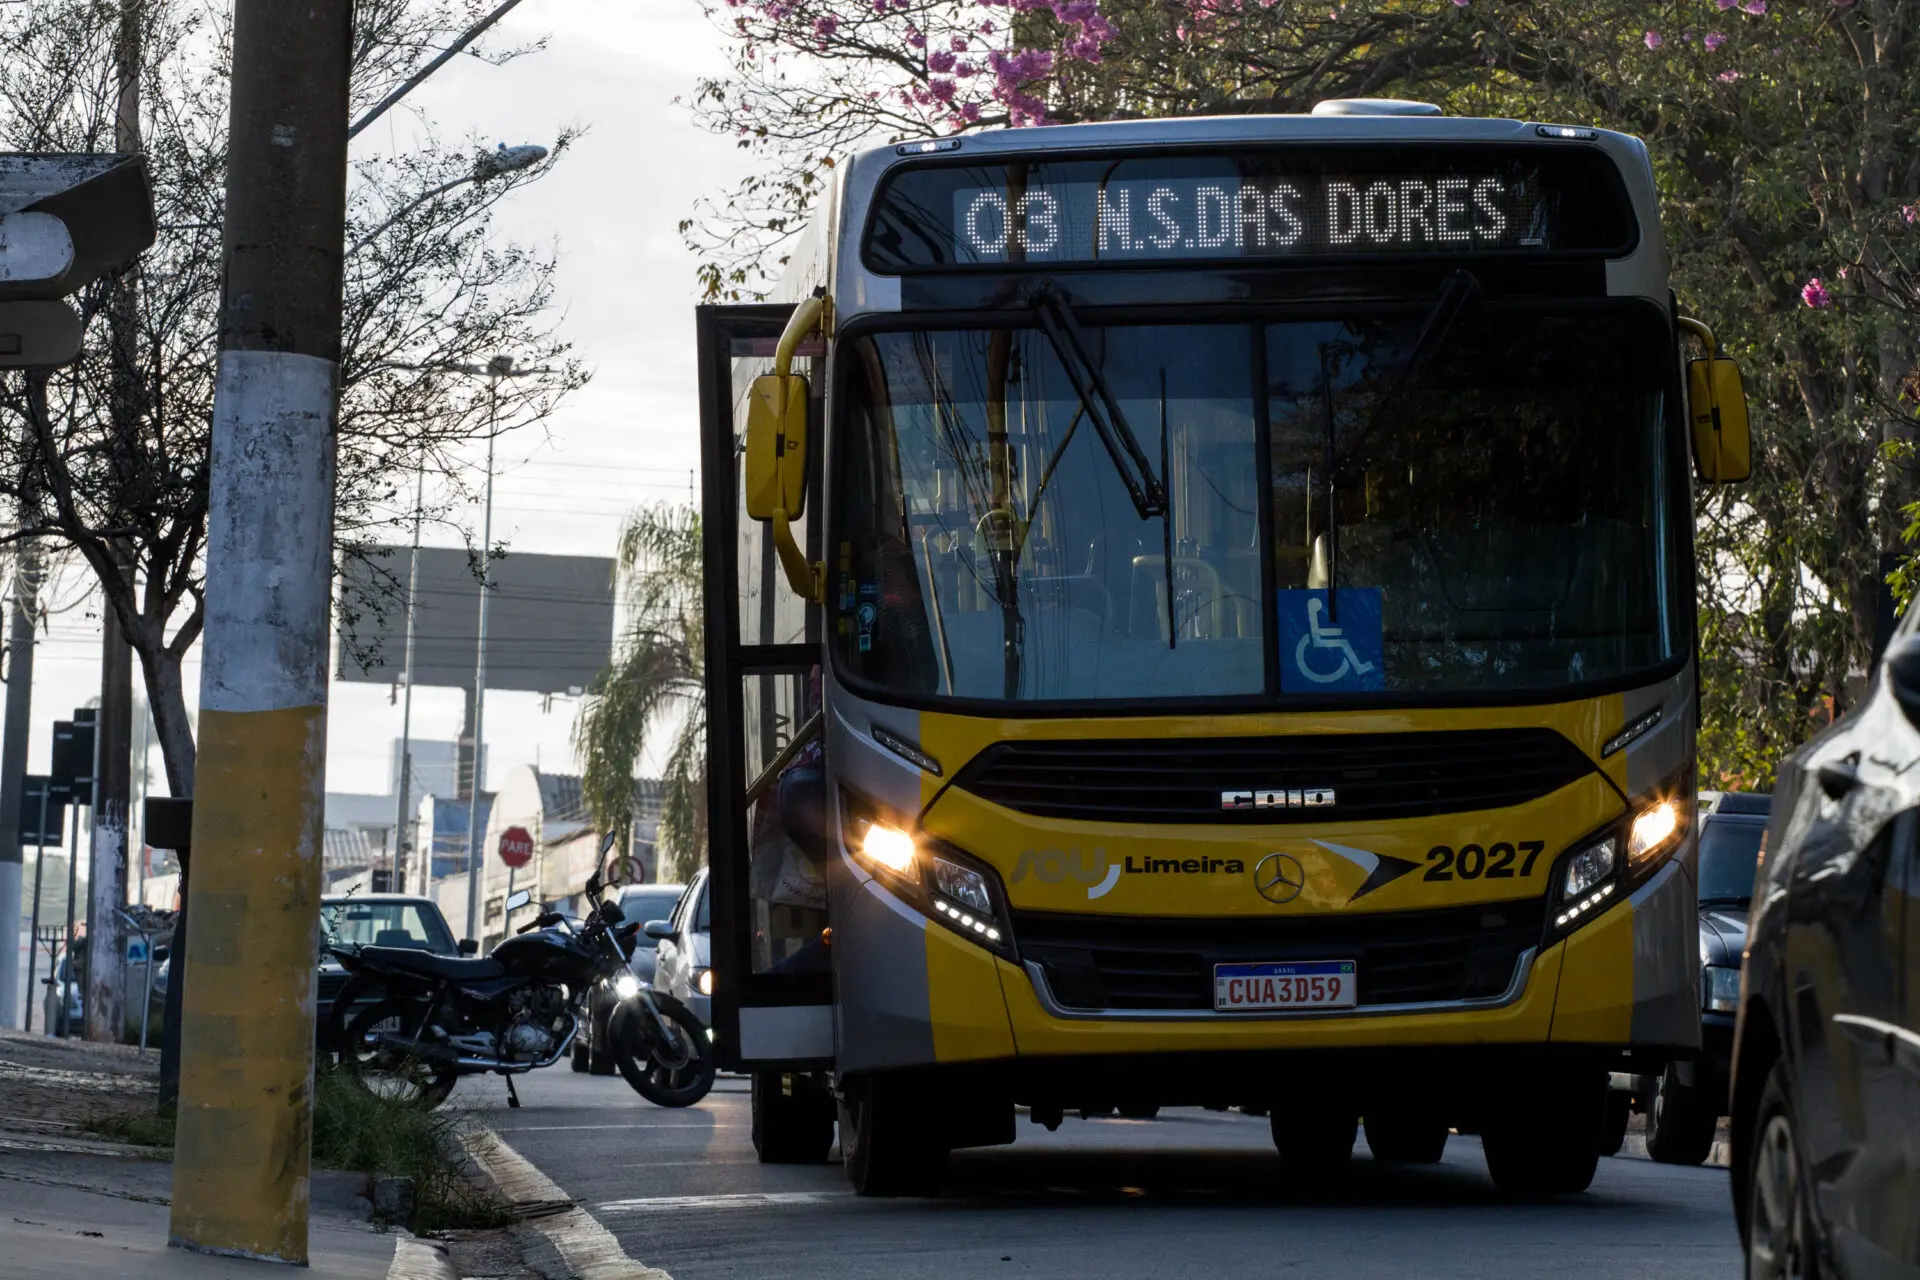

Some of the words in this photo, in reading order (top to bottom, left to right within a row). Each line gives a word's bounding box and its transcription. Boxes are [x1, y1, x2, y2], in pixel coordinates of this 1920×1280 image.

[965, 191, 1059, 255] 03
[1099, 183, 1305, 251] N.S.DAS
[1327, 177, 1509, 247] DORES
[502, 839, 532, 856] PARE
[1423, 841, 1545, 881] 2027
[1125, 856, 1244, 874] Limeira
[1229, 977, 1341, 1004] CUA3D59
